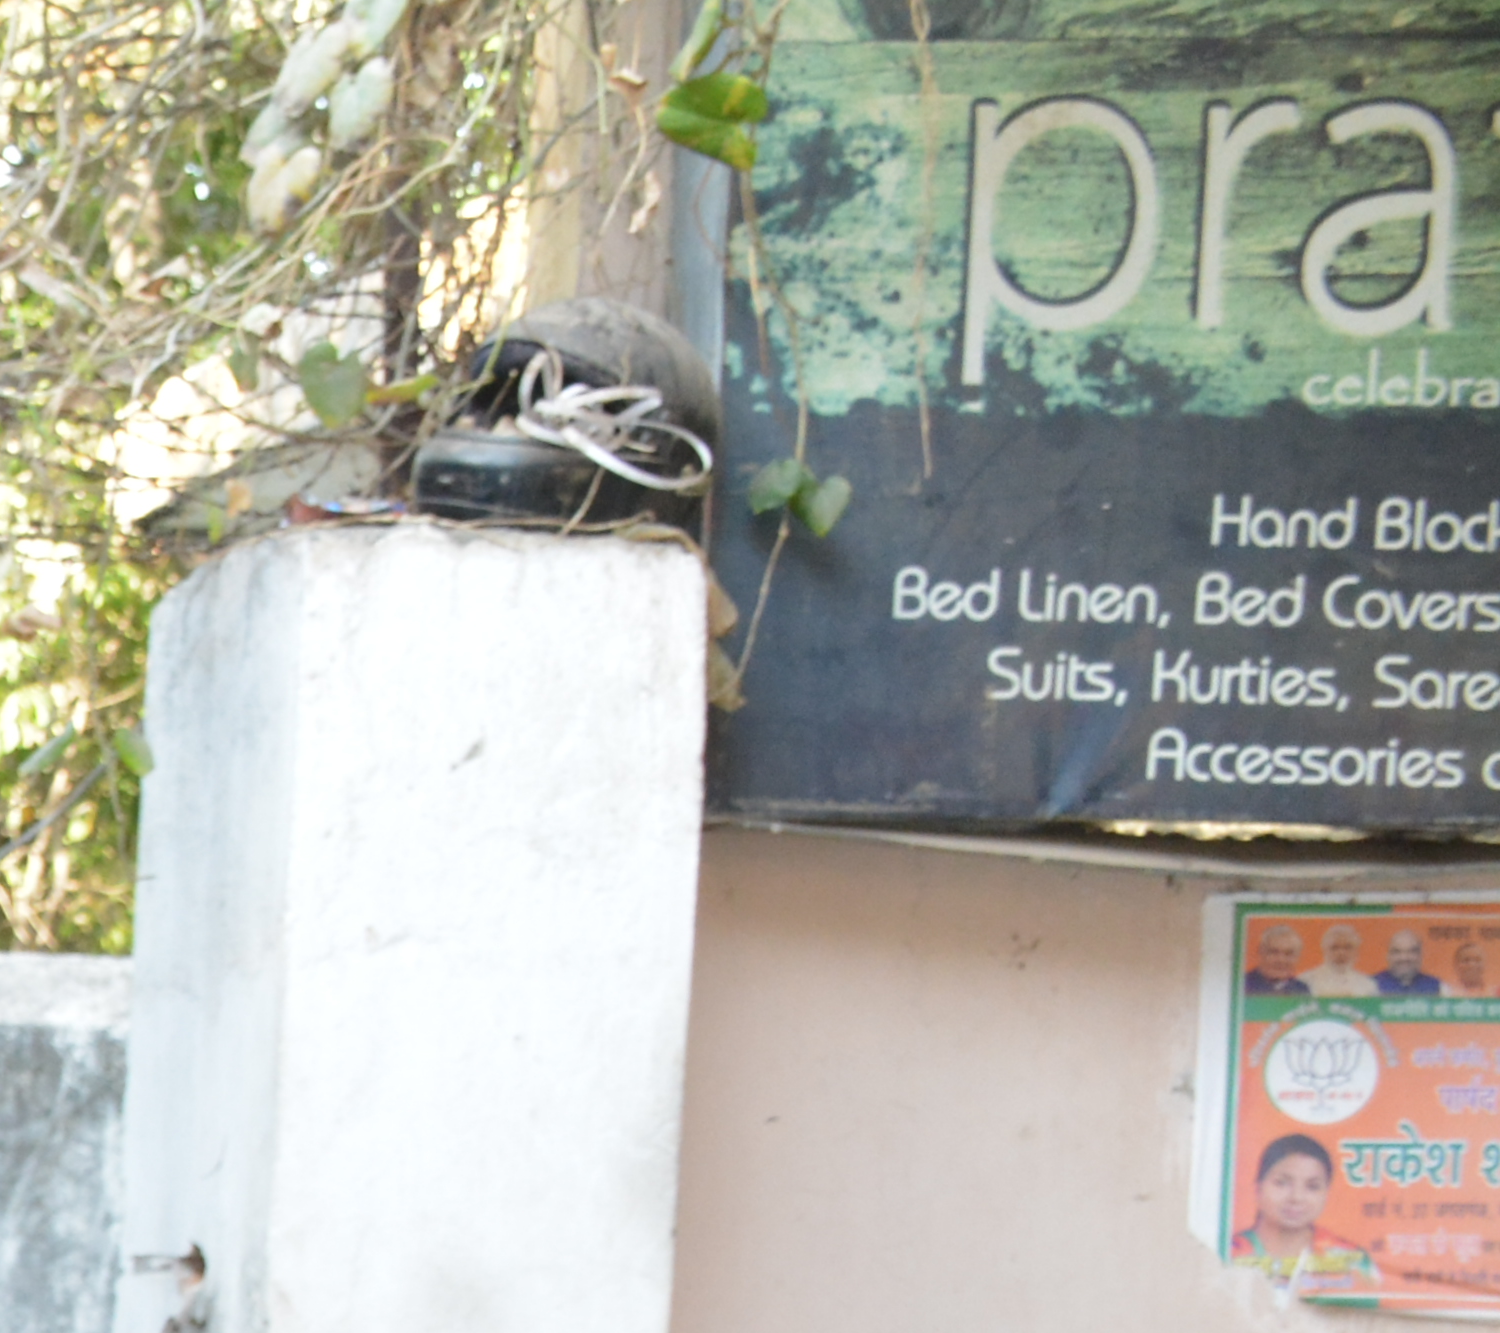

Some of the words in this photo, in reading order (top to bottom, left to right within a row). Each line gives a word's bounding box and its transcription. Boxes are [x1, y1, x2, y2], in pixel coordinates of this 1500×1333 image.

[961, 93, 1500, 386] pra
[1210, 494, 1359, 550] Hand
[892, 566, 1001, 622] Bed
[1019, 570, 1171, 629] Linen,
[1194, 572, 1305, 628] Bed
[1322, 574, 1500, 632] Covers
[987, 648, 1128, 707] Suits,
[1150, 650, 1350, 713] Kurties,
[1146, 728, 1466, 788] Accessories
[1341, 1120, 1467, 1187] राकेश
